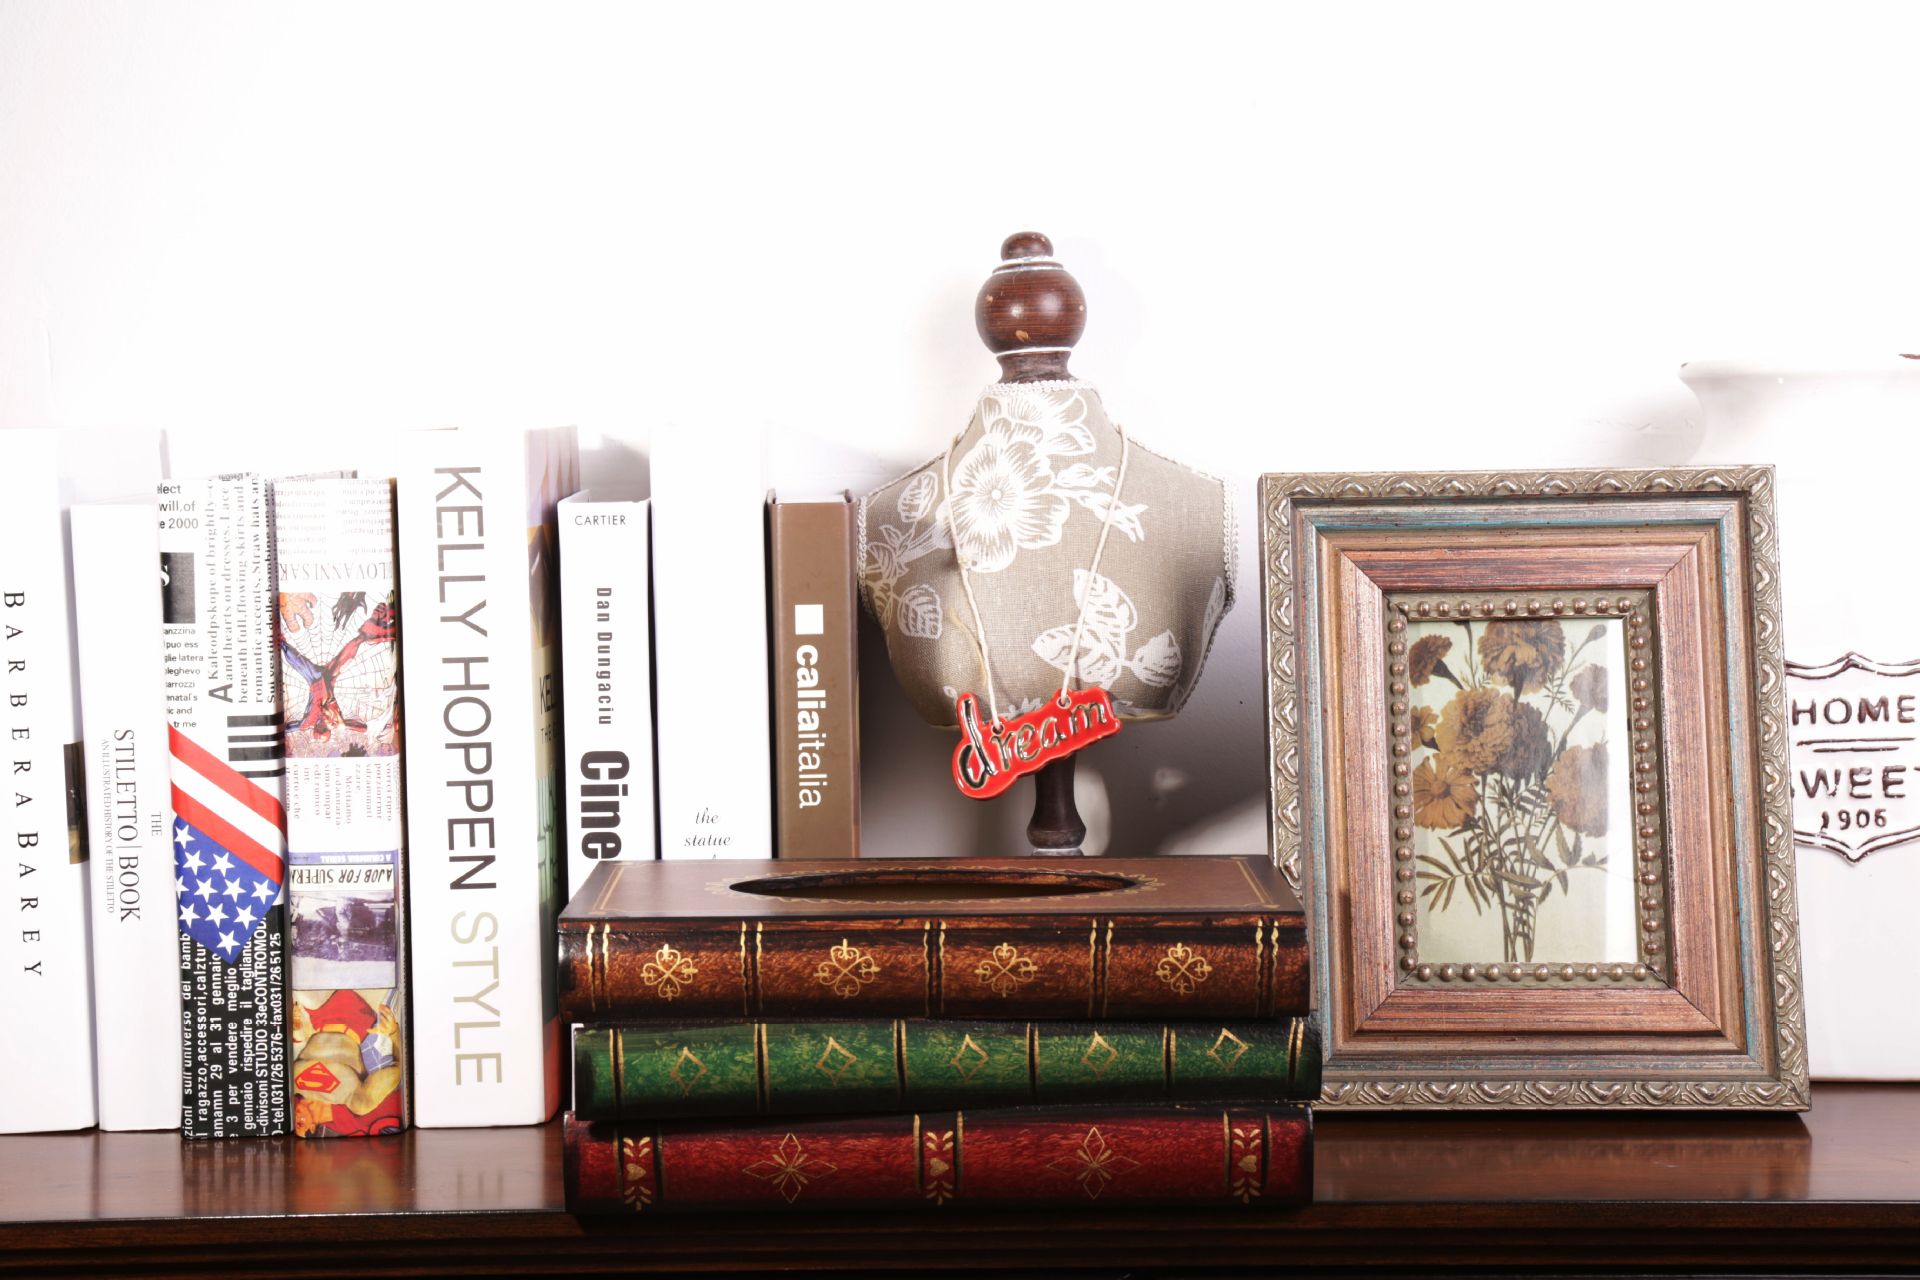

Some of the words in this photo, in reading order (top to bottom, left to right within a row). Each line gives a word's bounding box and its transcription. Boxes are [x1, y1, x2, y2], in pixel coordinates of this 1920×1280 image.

[234, 486, 245, 512] and
[249, 497, 260, 529] hats
[168, 518, 199, 530] 2000
[234, 515, 246, 556] skirts
[575, 515, 627, 526] CARTIER
[250, 534, 261, 573] Straw
[434, 466, 488, 637] KELLY
[596, 587, 613, 622] Dan
[221, 606, 232, 650] hearts
[222, 655, 233, 680] and
[236, 648, 248, 703] beneath
[252, 639, 263, 703] romantic
[596, 632, 614, 725] Dungaciu
[176, 706, 193, 714] and
[796, 644, 825, 810] caliaitalia
[1792, 694, 1916, 727] HOME
[101, 739, 110, 751] AN
[958, 699, 1107, 789] dream
[102, 752, 112, 808] ILLUSTRATED
[114, 729, 138, 842] STILETTO
[442, 655, 498, 891] HOPPEN
[1790, 765, 1920, 800] WEE
[152, 811, 163, 837] THE
[580, 750, 630, 861] Cine
[695, 807, 719, 825] the
[1820, 808, 1888, 834] 1906
[104, 808, 113, 844] HISTORY
[683, 834, 731, 847] statue
[105, 846, 114, 858] OF
[106, 859, 114, 874] THE
[107, 875, 116, 914] STILETTO
[119, 856, 141, 923] BOOK
[338, 868, 362, 884] FOR
[180, 932, 192, 970] bamb
[208, 953, 225, 1005] gennaio
[224, 968, 240, 1012] meglio
[240, 1001, 252, 1009] il
[451, 910, 504, 1086] STYLE
[210, 1017, 222, 1032] 31
[210, 1042, 222, 1054] al
[225, 1022, 237, 1074] vendere
[240, 1018, 255, 1072] rispedire
[255, 1029, 268, 1078] STUDIO
[210, 1064, 223, 1080] 29
[227, 1084, 240, 1105] per
[241, 1082, 257, 1130] gennaio
